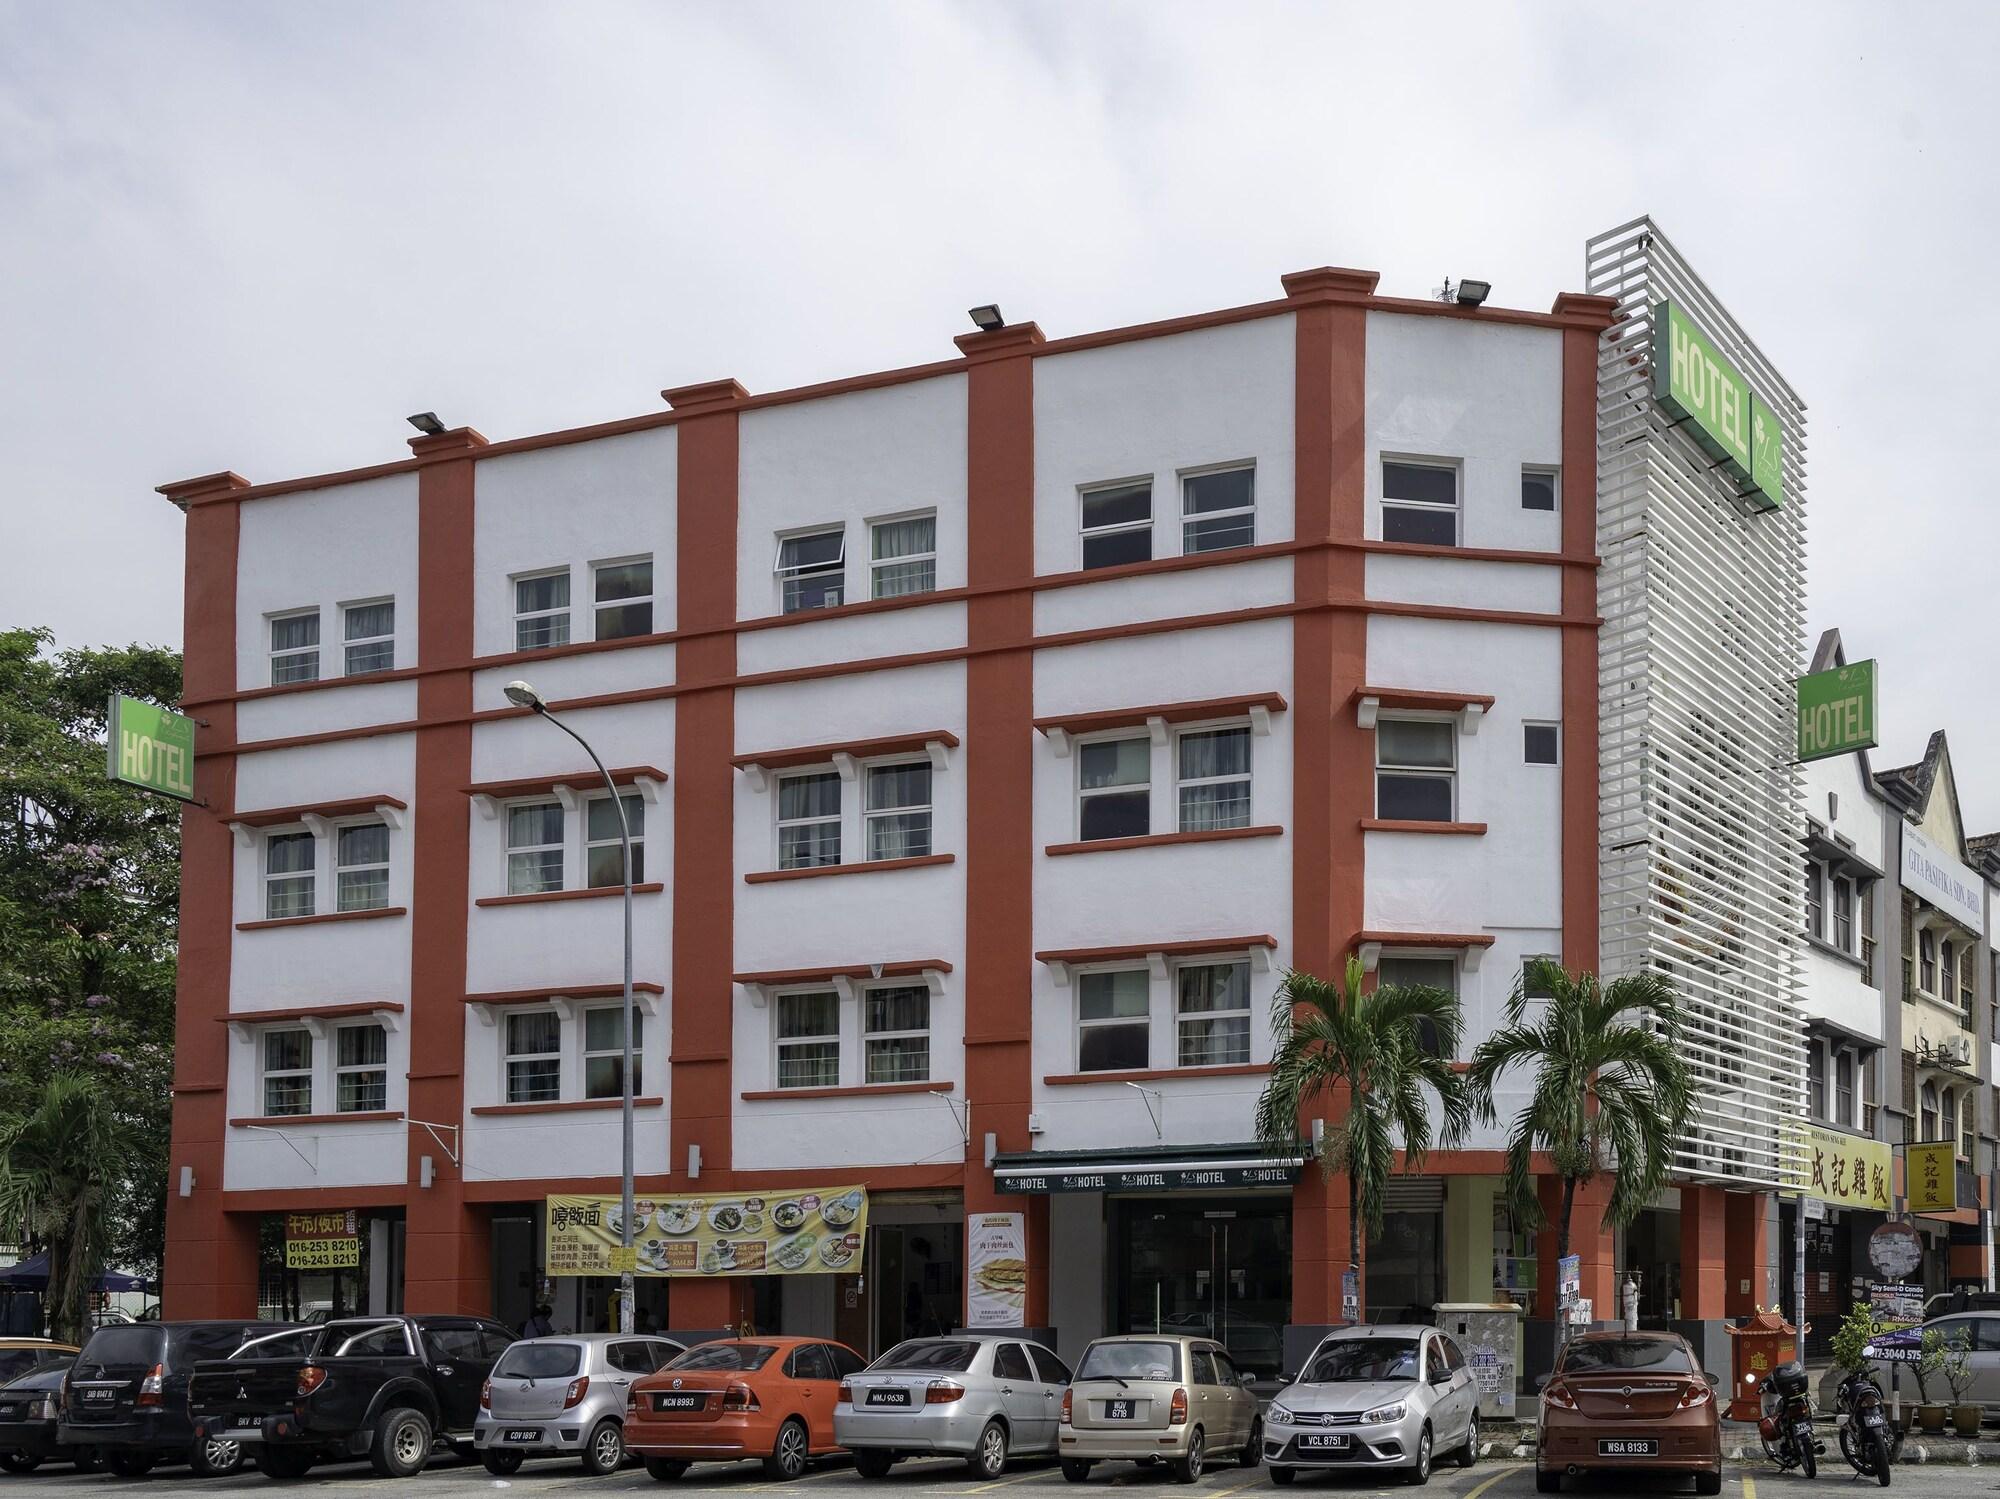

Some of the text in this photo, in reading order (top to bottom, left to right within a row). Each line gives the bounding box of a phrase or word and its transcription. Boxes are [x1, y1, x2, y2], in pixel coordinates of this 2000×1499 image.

[1672, 319, 1747, 456] HOTEL
[1801, 695, 1871, 753] HOTEL
[122, 729, 191, 794] HOTEL
[1136, 1173, 1166, 1186] HOTEL
[1196, 1171, 1226, 1184] HOTEL
[1258, 1168, 1288, 1181] HOTEL
[1020, 1177, 1048, 1190] HOTEL
[1078, 1175, 1106, 1188] HOTEL
[289, 1240, 357, 1253] 016-253 8210
[289, 1254, 358, 1266] 016-243 8213
[1871, 1284, 1882, 1292] Sky
[1907, 1349, 1922, 1360] 575
[676, 1397, 695, 1406] 8993
[872, 1393, 905, 1402] WMJ 9638
[1112, 1409, 1127, 1418] 6718
[1308, 1435, 1341, 1446] VCL 8751
[1607, 1442, 1649, 1453] WSA 8133
